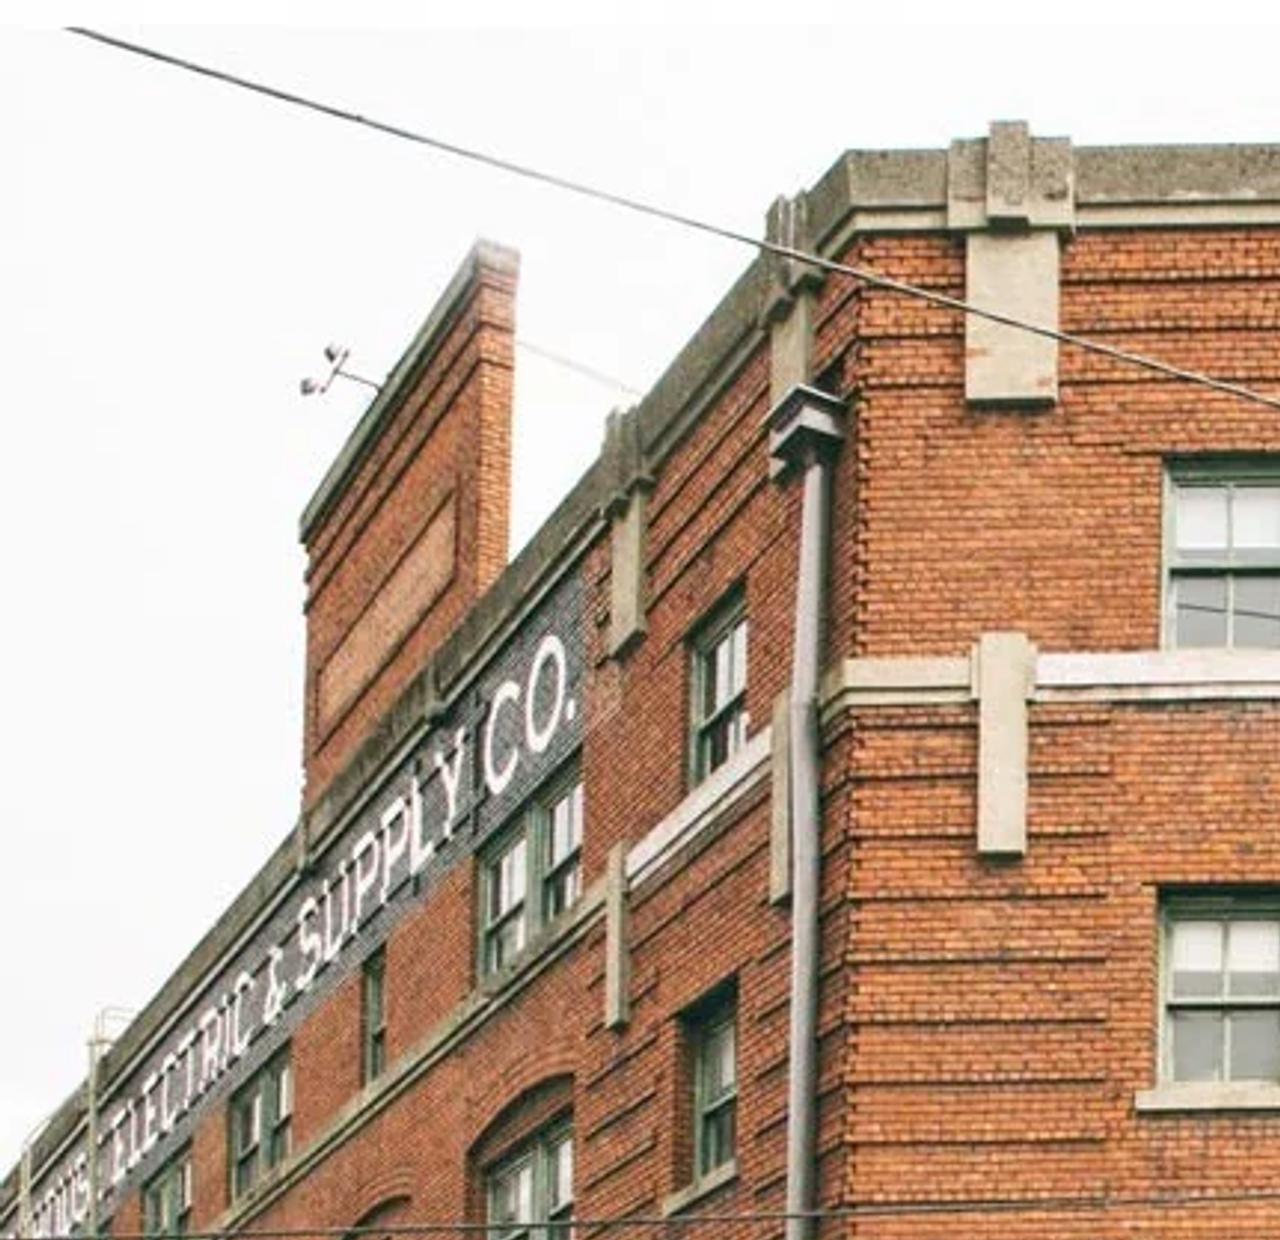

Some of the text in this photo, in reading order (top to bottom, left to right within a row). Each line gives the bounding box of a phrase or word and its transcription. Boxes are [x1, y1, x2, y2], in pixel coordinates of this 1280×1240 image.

[263, 946, 287, 1027] &
[295, 726, 466, 990] SUPPLY
[484, 635, 575, 795] CO.
